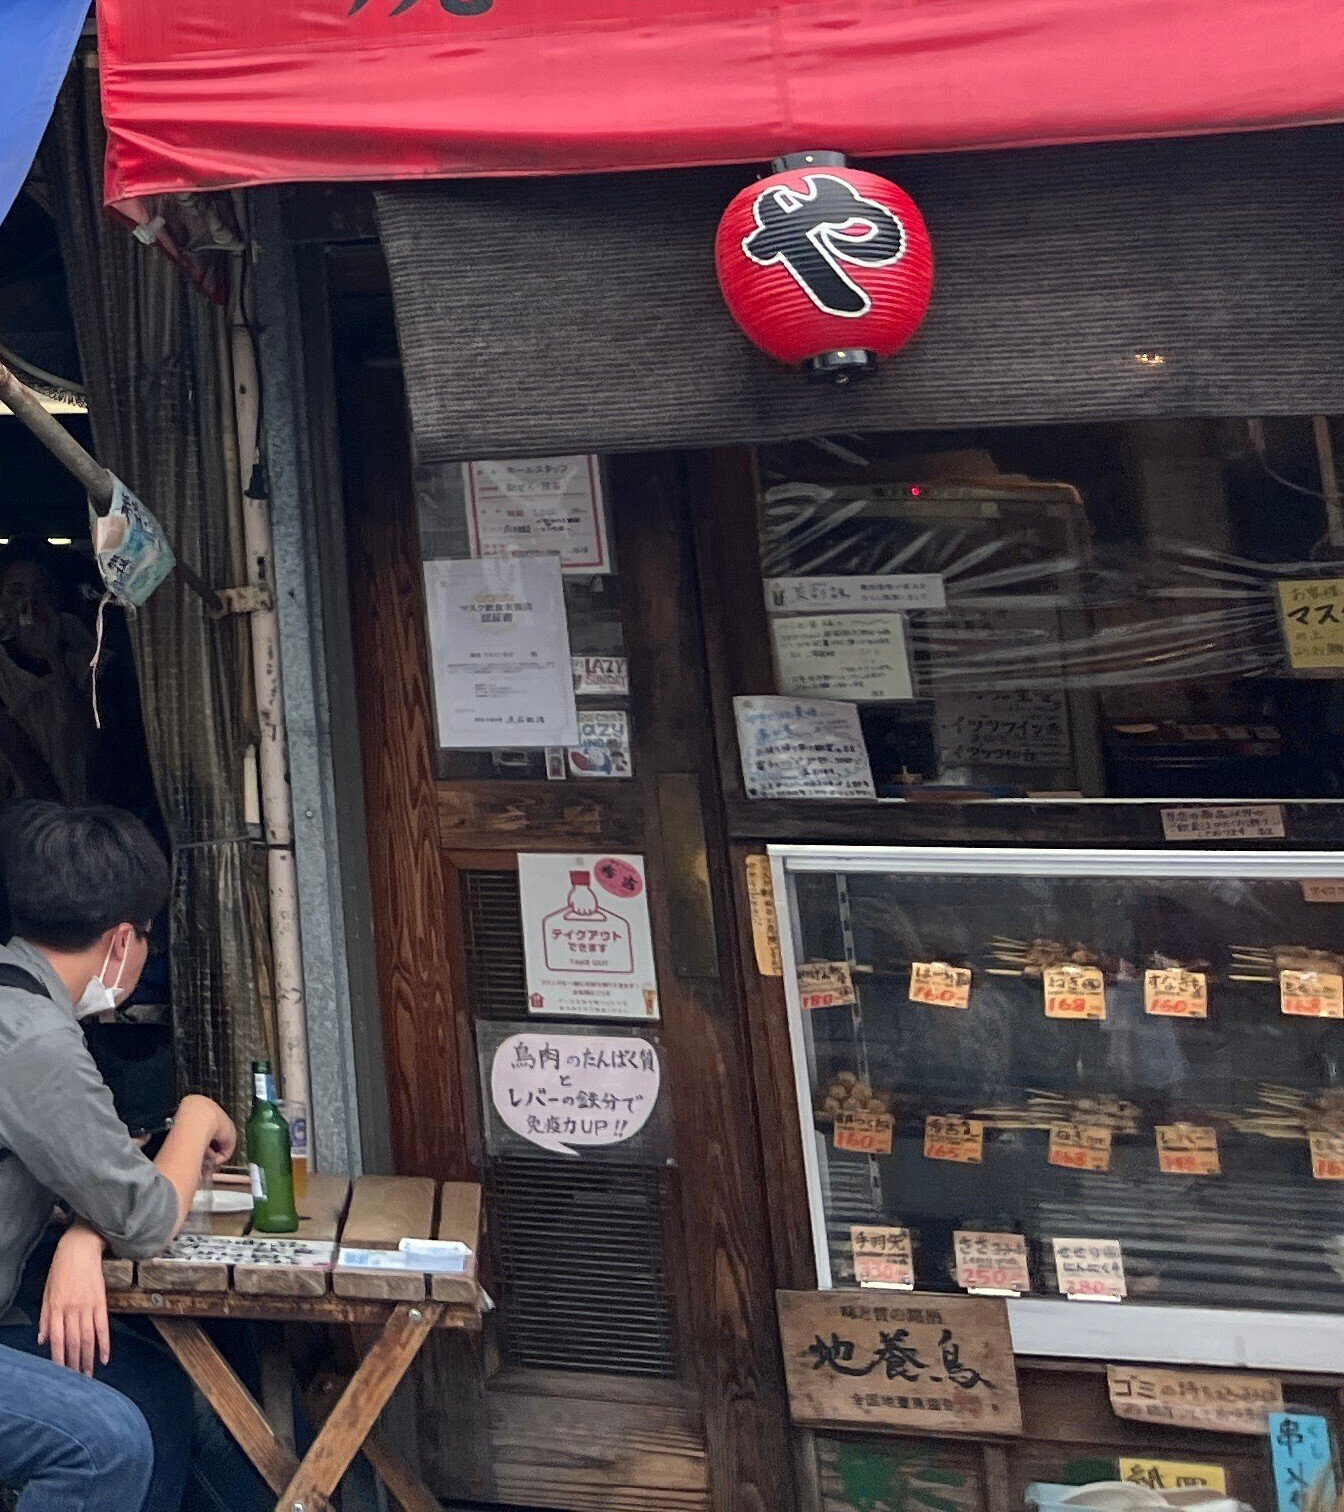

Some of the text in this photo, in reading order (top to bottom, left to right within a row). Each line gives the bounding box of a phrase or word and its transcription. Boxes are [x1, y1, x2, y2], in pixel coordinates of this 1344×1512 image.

[1288, 604, 1344, 625] マス
[560, 1074, 572, 1087] と
[508, 1087, 644, 1114] レバーの鉄分で
